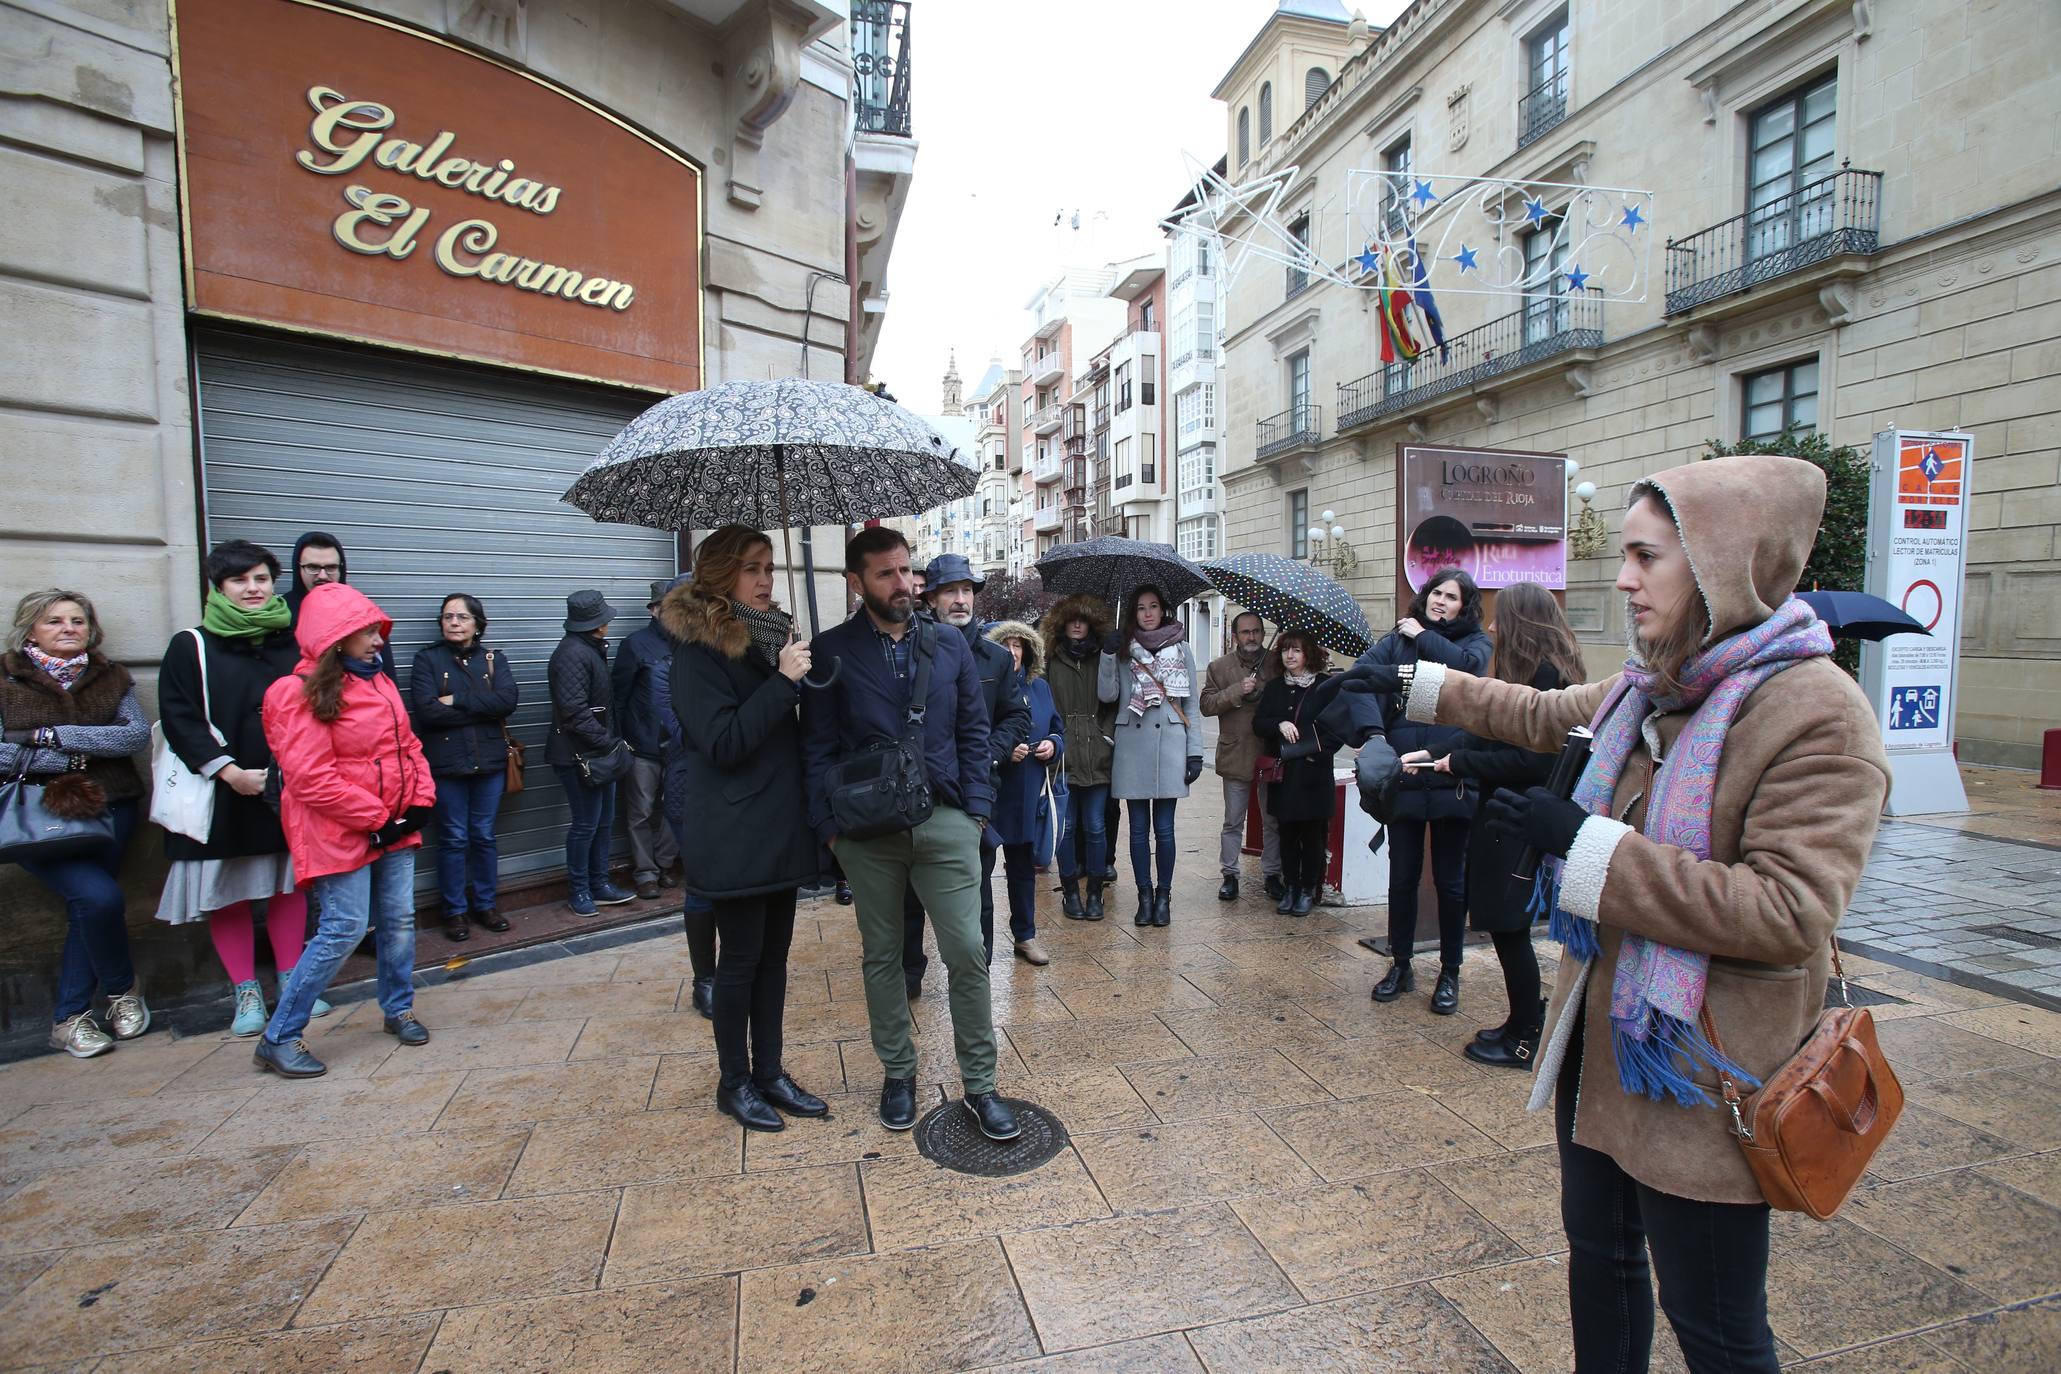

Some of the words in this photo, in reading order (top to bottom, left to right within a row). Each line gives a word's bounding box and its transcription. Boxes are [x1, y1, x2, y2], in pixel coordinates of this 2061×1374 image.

[295, 84, 563, 217] Galerias
[332, 184, 431, 260] El
[433, 218, 635, 312] Carmen
[1505, 491, 1535, 506] RIOJA
[1893, 537, 1922, 546] CONTROL
[1892, 547, 1916, 556] LECTOR
[1916, 548, 1924, 556] DE
